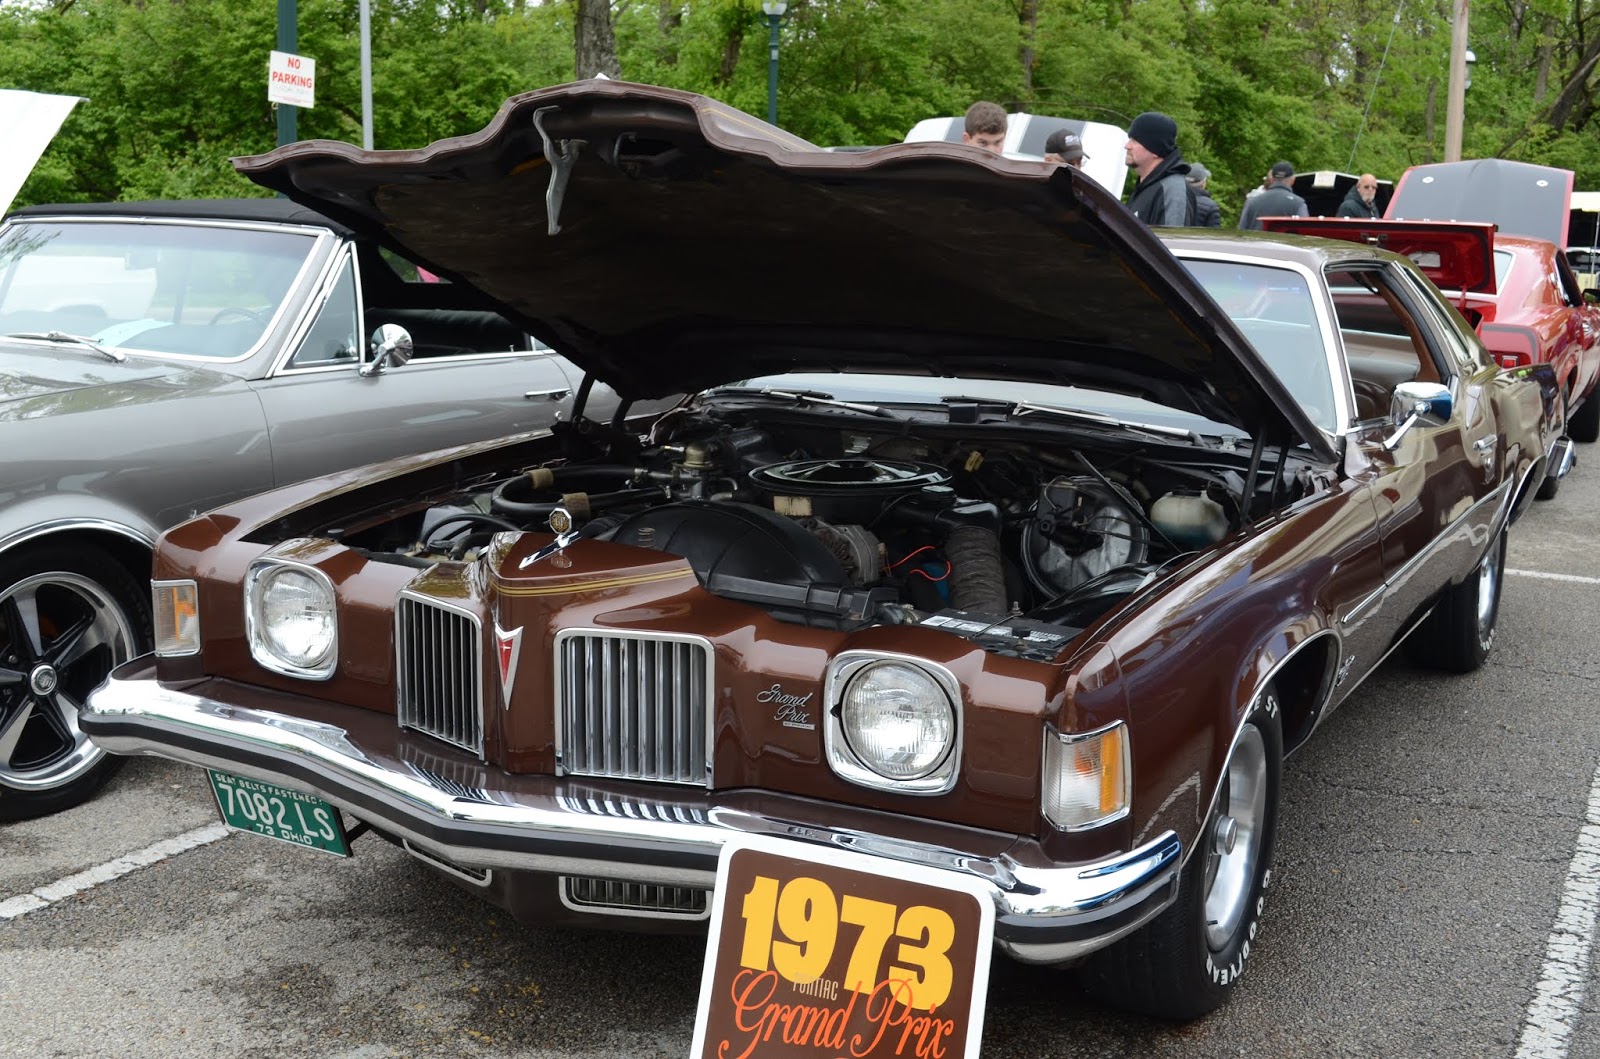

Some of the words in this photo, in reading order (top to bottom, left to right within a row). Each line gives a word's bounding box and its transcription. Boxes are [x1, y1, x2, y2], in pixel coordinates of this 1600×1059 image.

[287, 57, 301, 69] NO
[272, 71, 313, 89] PARKING
[756, 683, 814, 708] Grand
[773, 703, 811, 724] Prix
[215, 773, 236, 786] SEAT
[240, 780, 267, 793] BELTS
[218, 782, 293, 831] 7082
[294, 802, 335, 841] LS
[256, 823, 276, 836] 73
[281, 829, 313, 846] OHIO
[1206, 869, 1271, 986] GOODYEAR
[740, 875, 956, 1011] 1973
[792, 972, 839, 1001] PONTIAC
[717, 969, 862, 1059] Grand
[849, 978, 955, 1059] Prix
